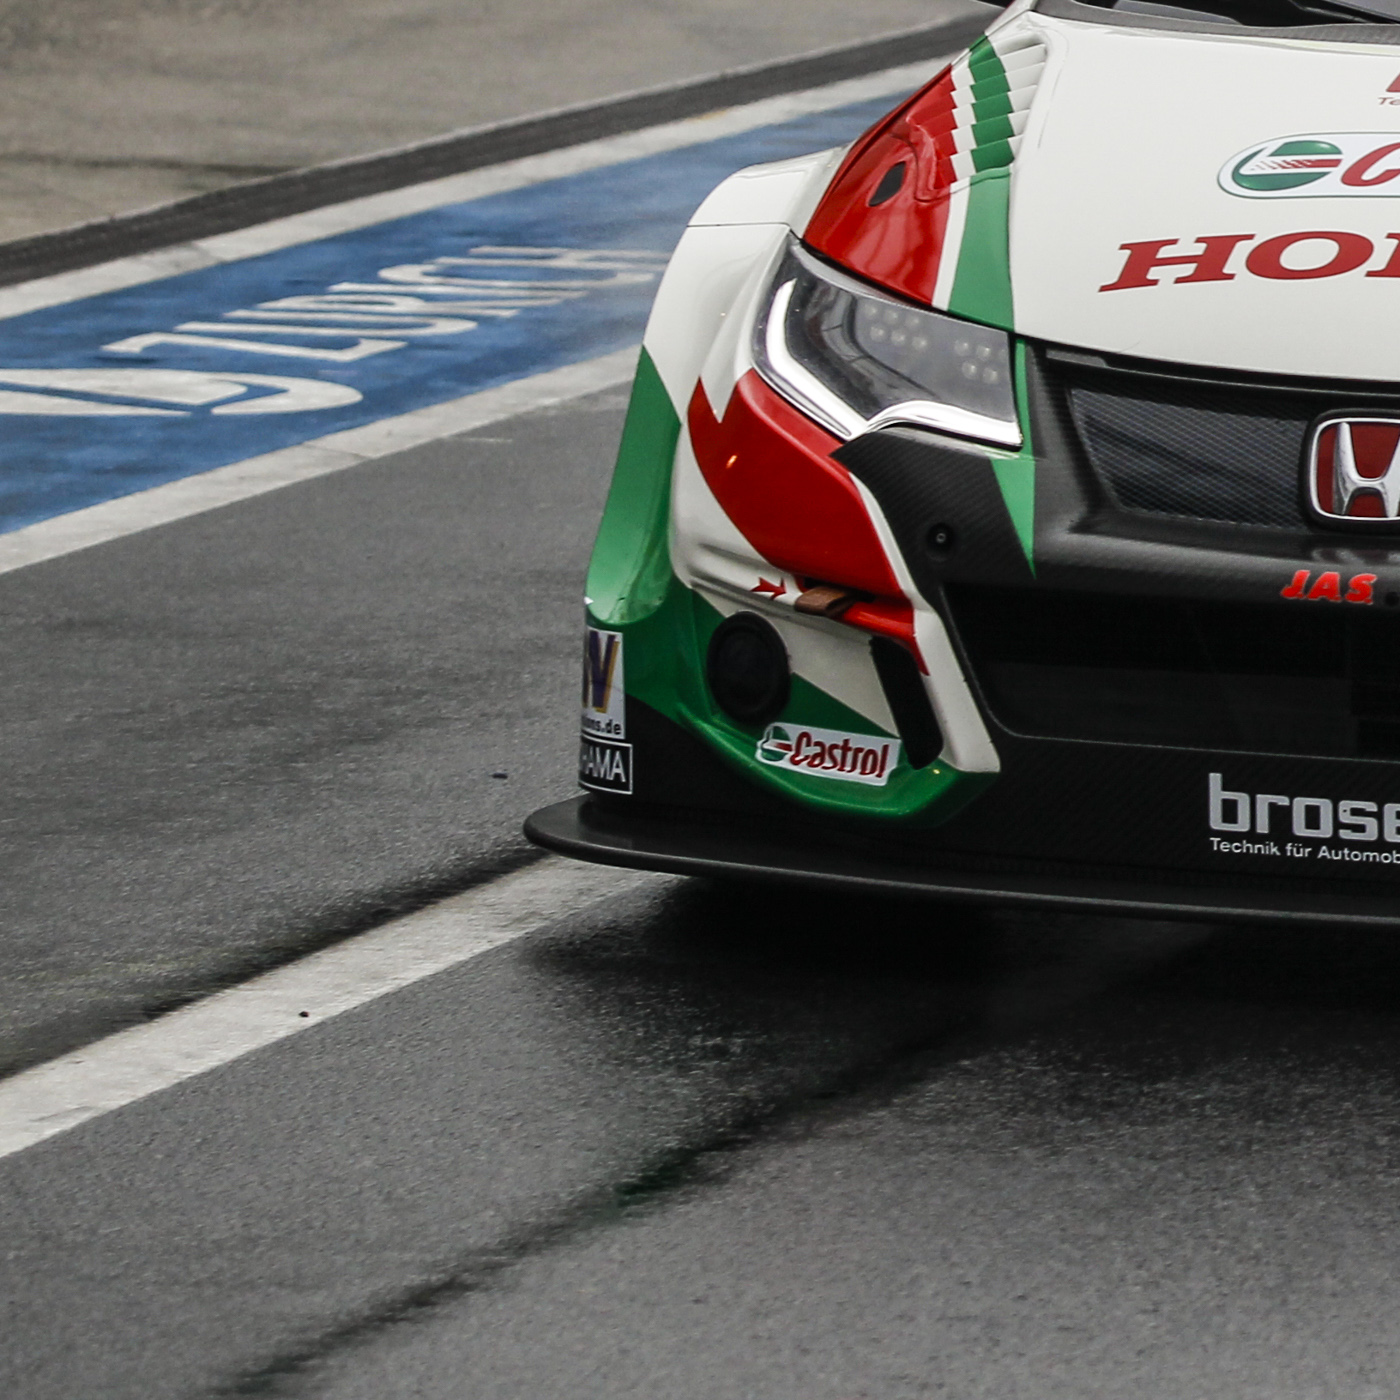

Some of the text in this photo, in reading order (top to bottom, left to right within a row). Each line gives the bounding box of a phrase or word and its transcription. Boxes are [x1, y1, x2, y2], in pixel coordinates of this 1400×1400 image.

[790, 731, 890, 779] Castrol
[1209, 836, 1282, 857] Technik
[1284, 840, 1313, 858] für
